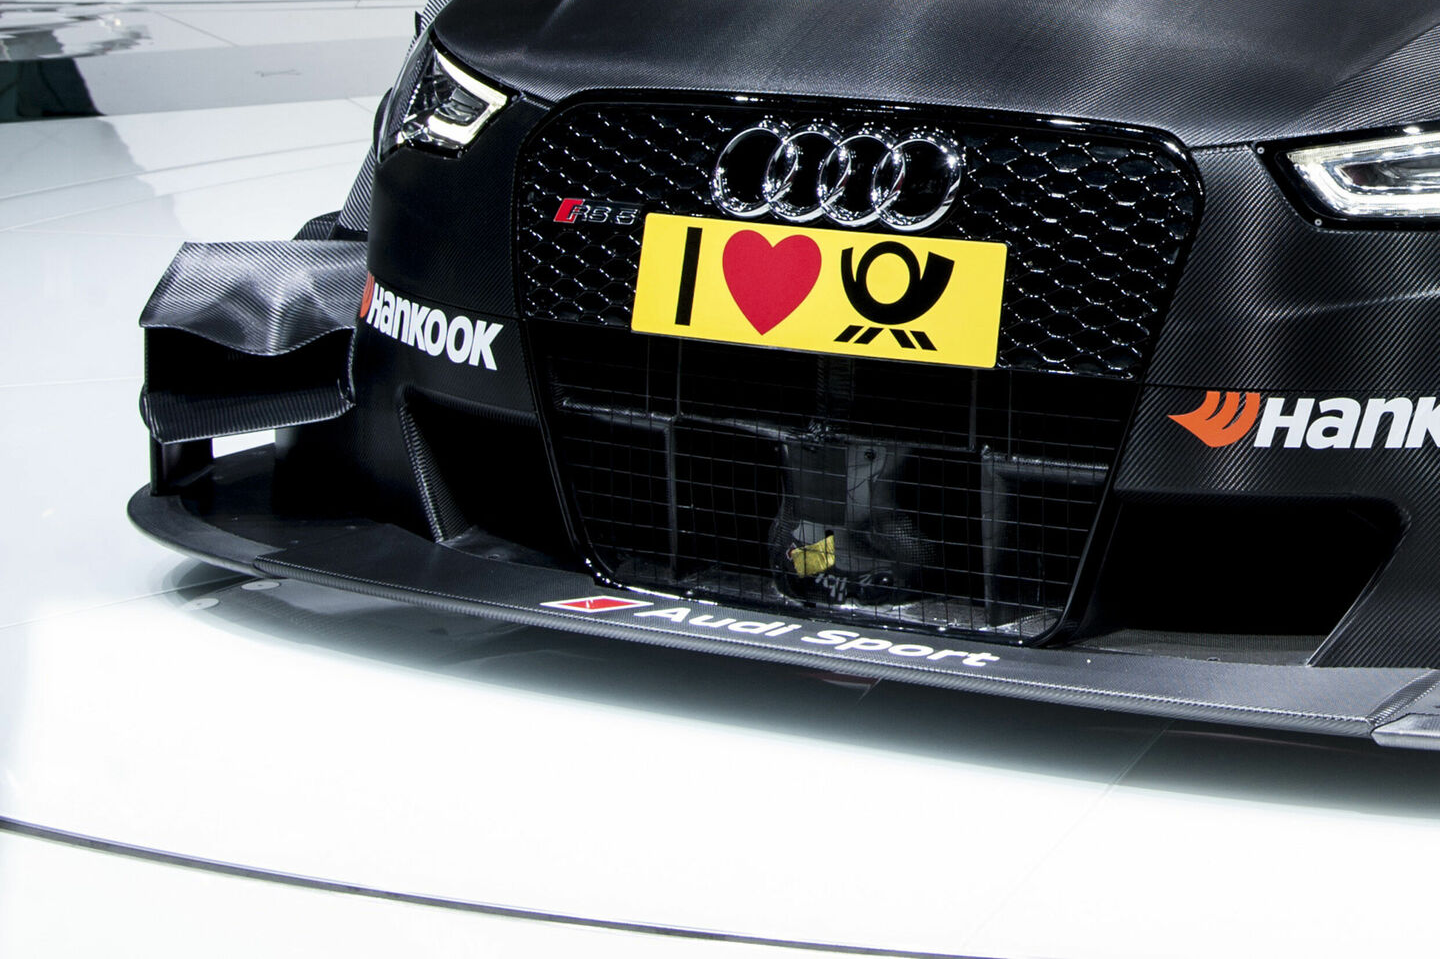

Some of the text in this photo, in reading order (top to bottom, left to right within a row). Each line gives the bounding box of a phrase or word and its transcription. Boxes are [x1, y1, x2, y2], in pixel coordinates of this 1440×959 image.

[675, 226, 703, 326] I
[633, 606, 1000, 668] Audi Sport
